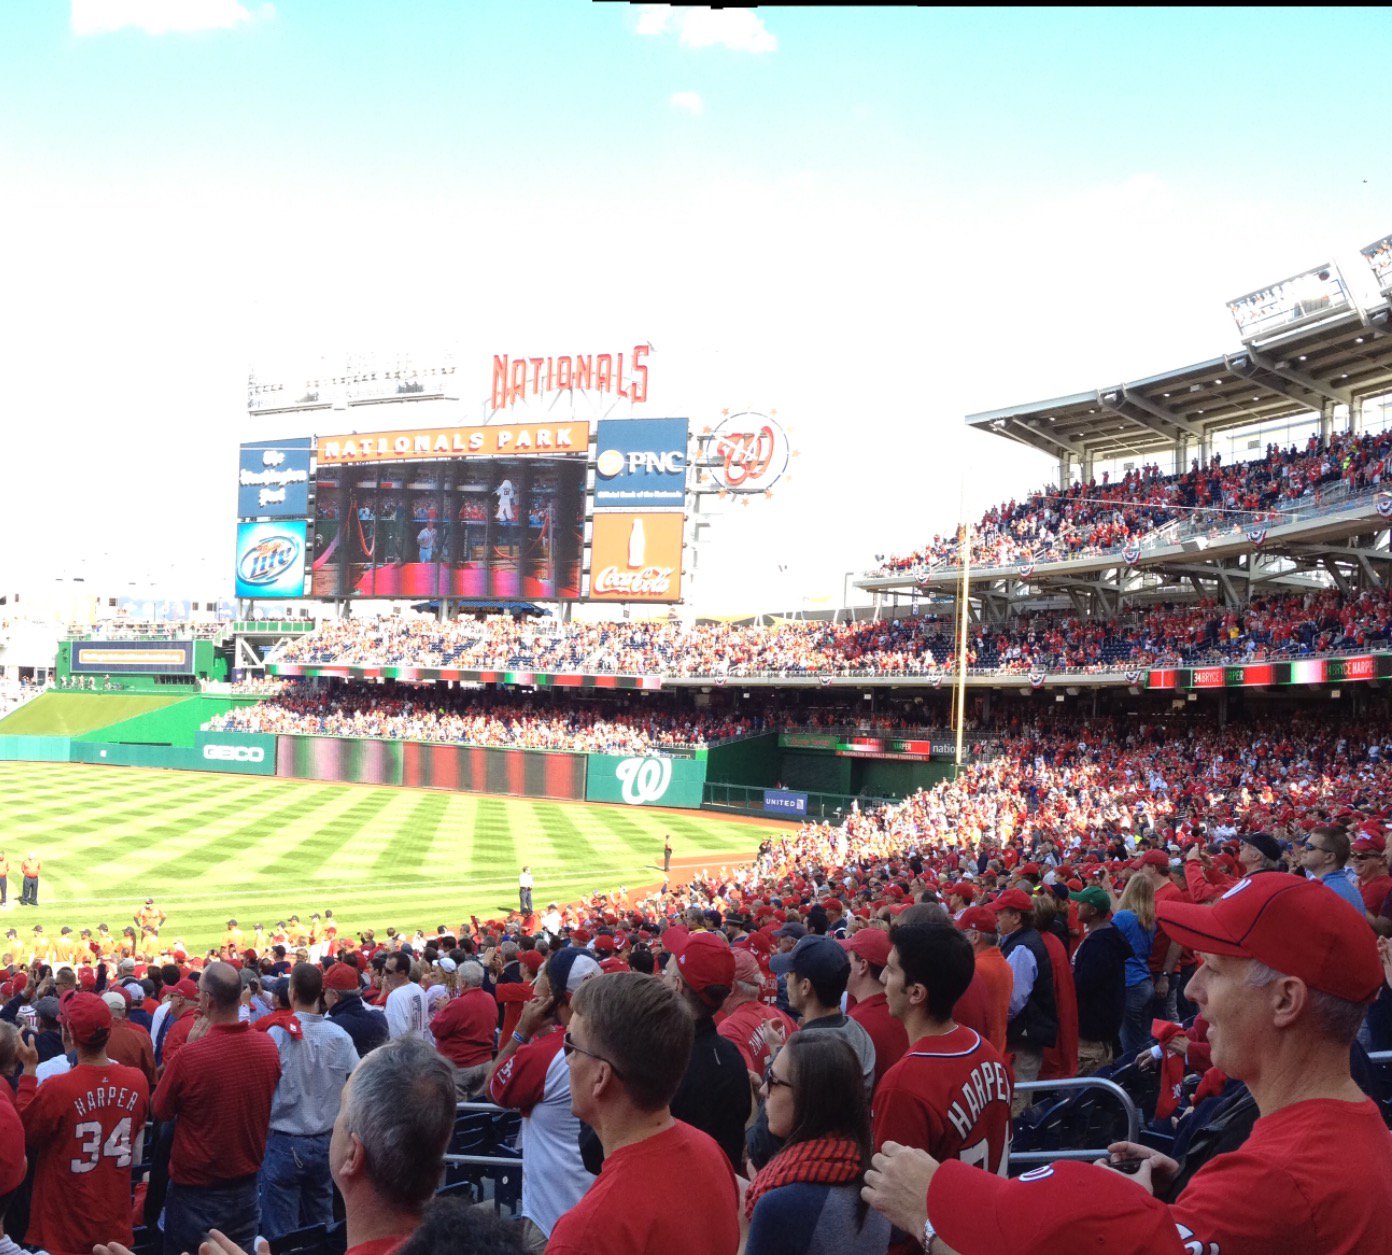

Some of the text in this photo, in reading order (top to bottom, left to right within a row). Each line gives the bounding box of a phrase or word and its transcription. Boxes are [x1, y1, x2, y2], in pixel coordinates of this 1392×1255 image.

[491, 345, 649, 410] NATIONALS
[324, 427, 573, 458] NATIONALS PARK
[627, 450, 684, 475] PNC
[204, 744, 265, 763] GEICO
[932, 744, 970, 755] natioal
[765, 798, 796, 807] UNITED
[74, 1086, 139, 1117] HARPER
[947, 1061, 1012, 1141] HARPE
[70, 1116, 133, 1174] 34
